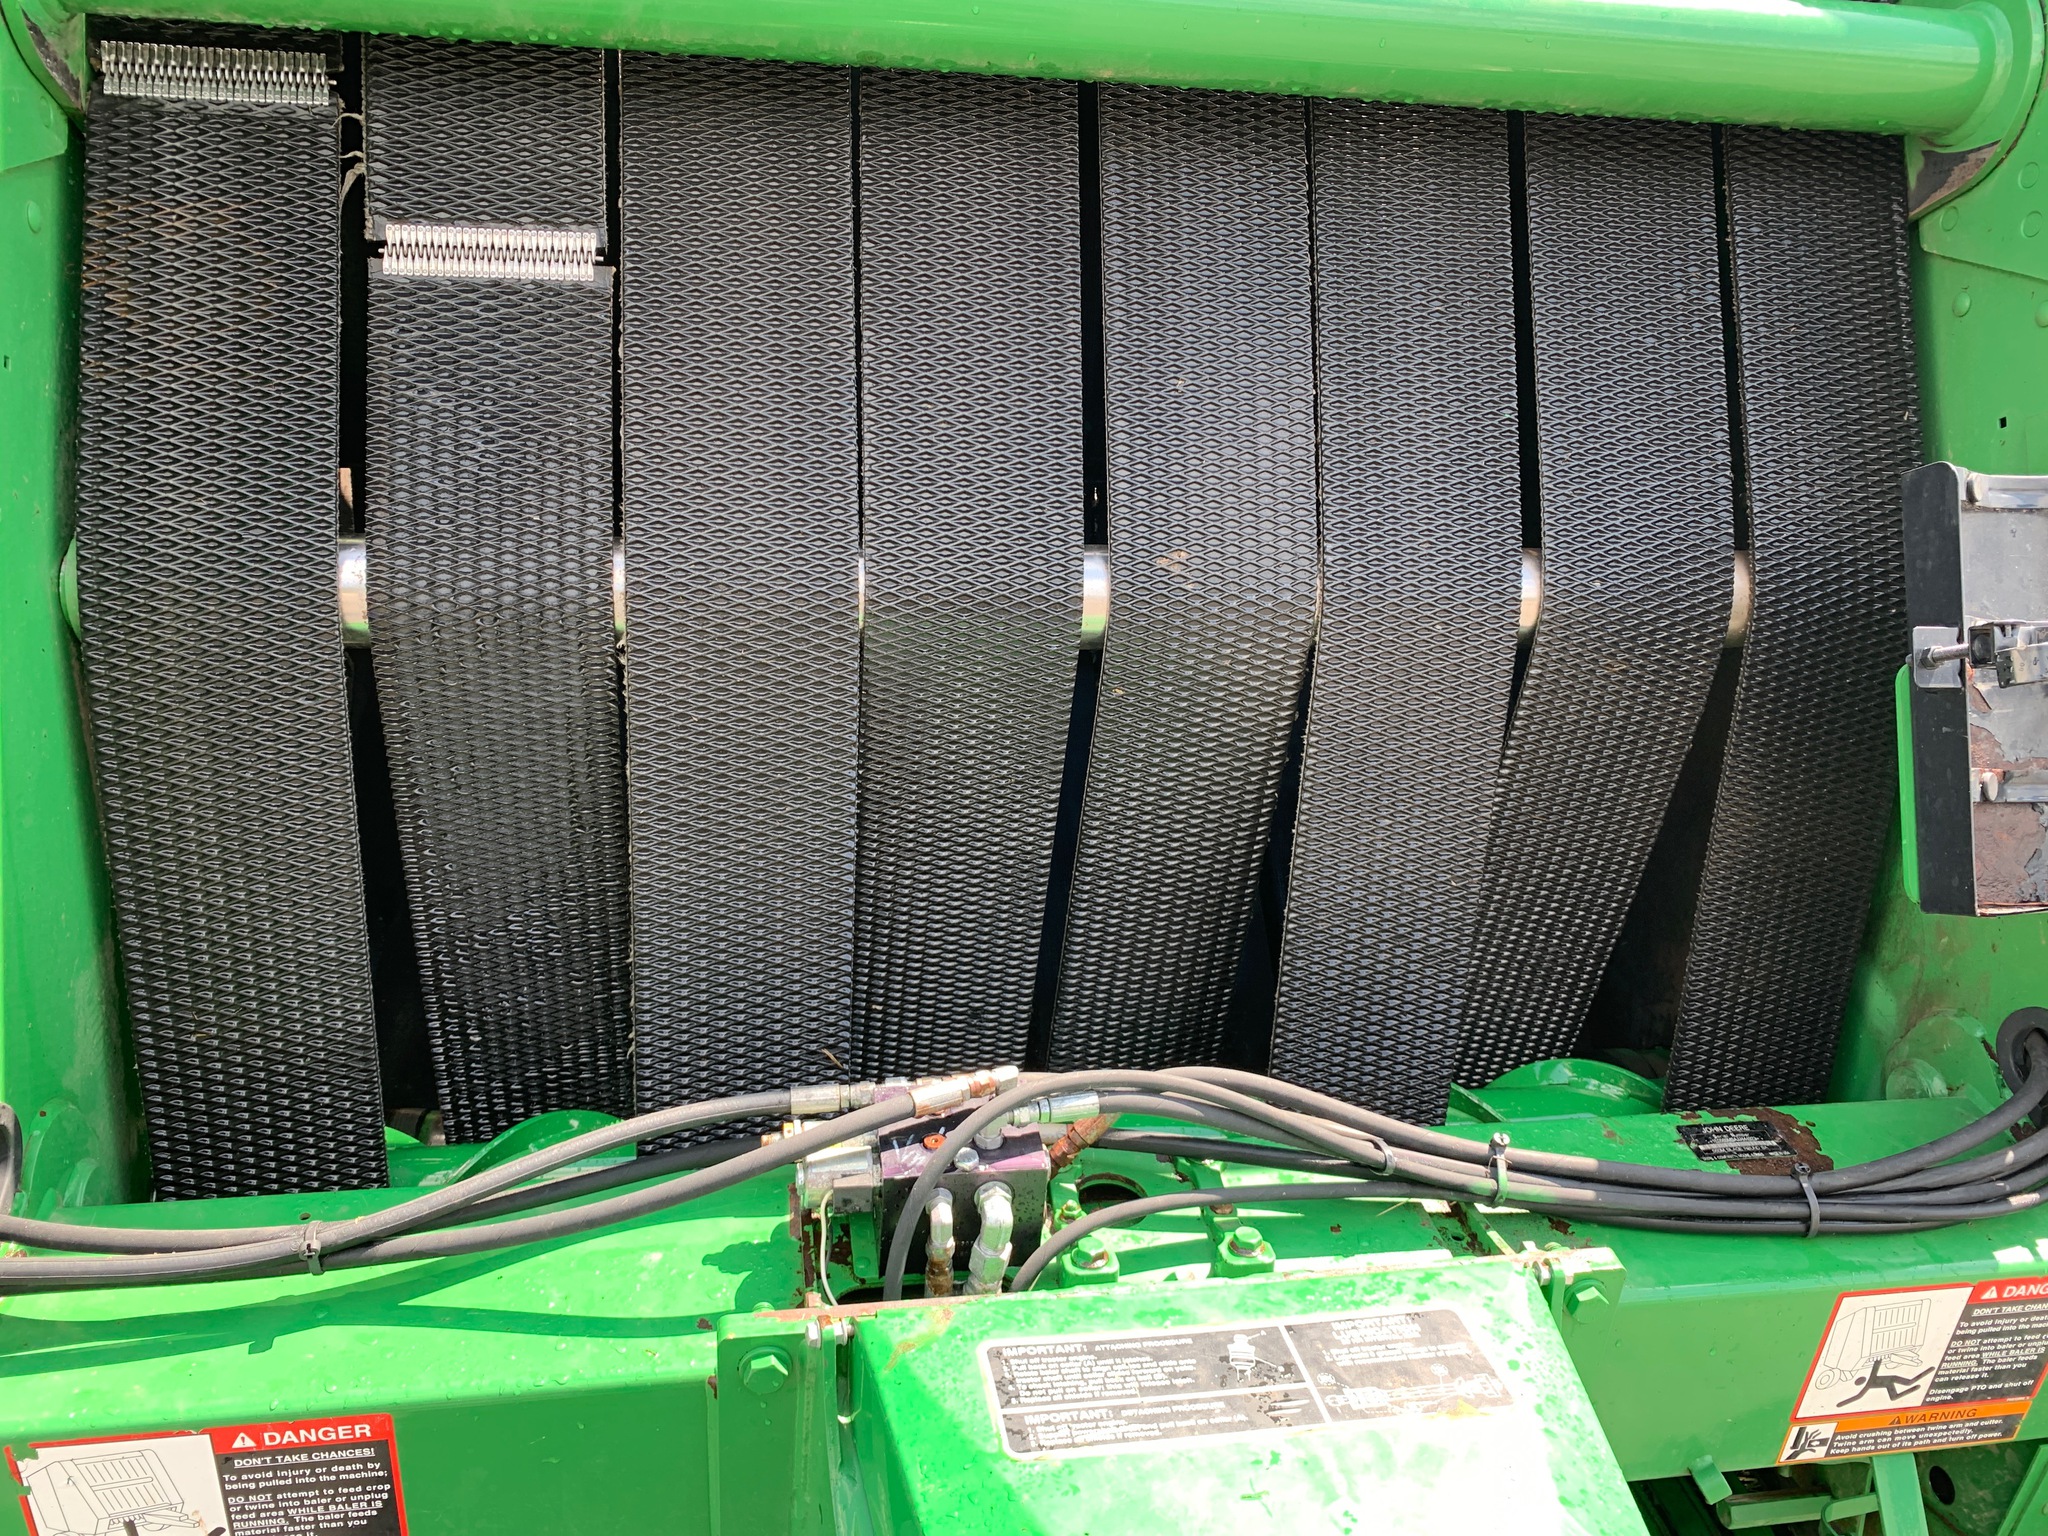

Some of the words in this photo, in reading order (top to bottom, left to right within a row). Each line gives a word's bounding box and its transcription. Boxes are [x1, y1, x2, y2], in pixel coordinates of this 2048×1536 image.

[1973, 1307, 2000, 1315] DON'T
[1929, 1387, 1969, 1395] Disengage
[1905, 1409, 1977, 1424] WARNING
[263, 1424, 372, 1446] DANGER
[1835, 1433, 1857, 1441] Avoid
[1859, 1430, 1892, 1439] crushing
[1913, 1439, 1930, 1447] path
[1978, 1432, 2003, 1440] power.
[1919, 1429, 1973, 1439] unexpectedly.
[234, 1457, 272, 1467] DON'T
[275, 1454, 309, 1463] TAKE
[311, 1448, 375, 1460] CHANCES!
[241, 1471, 273, 1480] avoid
[277, 1469, 311, 1477] injury
[331, 1463, 363, 1472] death
[367, 1462, 381, 1470] by
[259, 1479, 292, 1488] pulled
[340, 1471, 388, 1480] machine;
[245, 1503, 275, 1511] twine
[279, 1500, 300, 1508] into
[304, 1498, 332, 1506] baler
[350, 1493, 389, 1501] unplug
[249, 1494, 272, 1502] NOT
[277, 1490, 319, 1499] attempt
[338, 1486, 362, 1494] feed
[231, 1512, 256, 1520] feed
[260, 1510, 284, 1518] area
[287, 1506, 324, 1515] WHILE
[329, 1502, 368, 1511] BALER
[233, 1518, 289, 1530] RUNNING.
[318, 1513, 345, 1521] baler
[348, 1510, 377, 1518] feeds
[235, 1527, 280, 1536] material
[283, 1524, 316, 1532] faster
[319, 1521, 344, 1529] than
[347, 1519, 367, 1527] you
